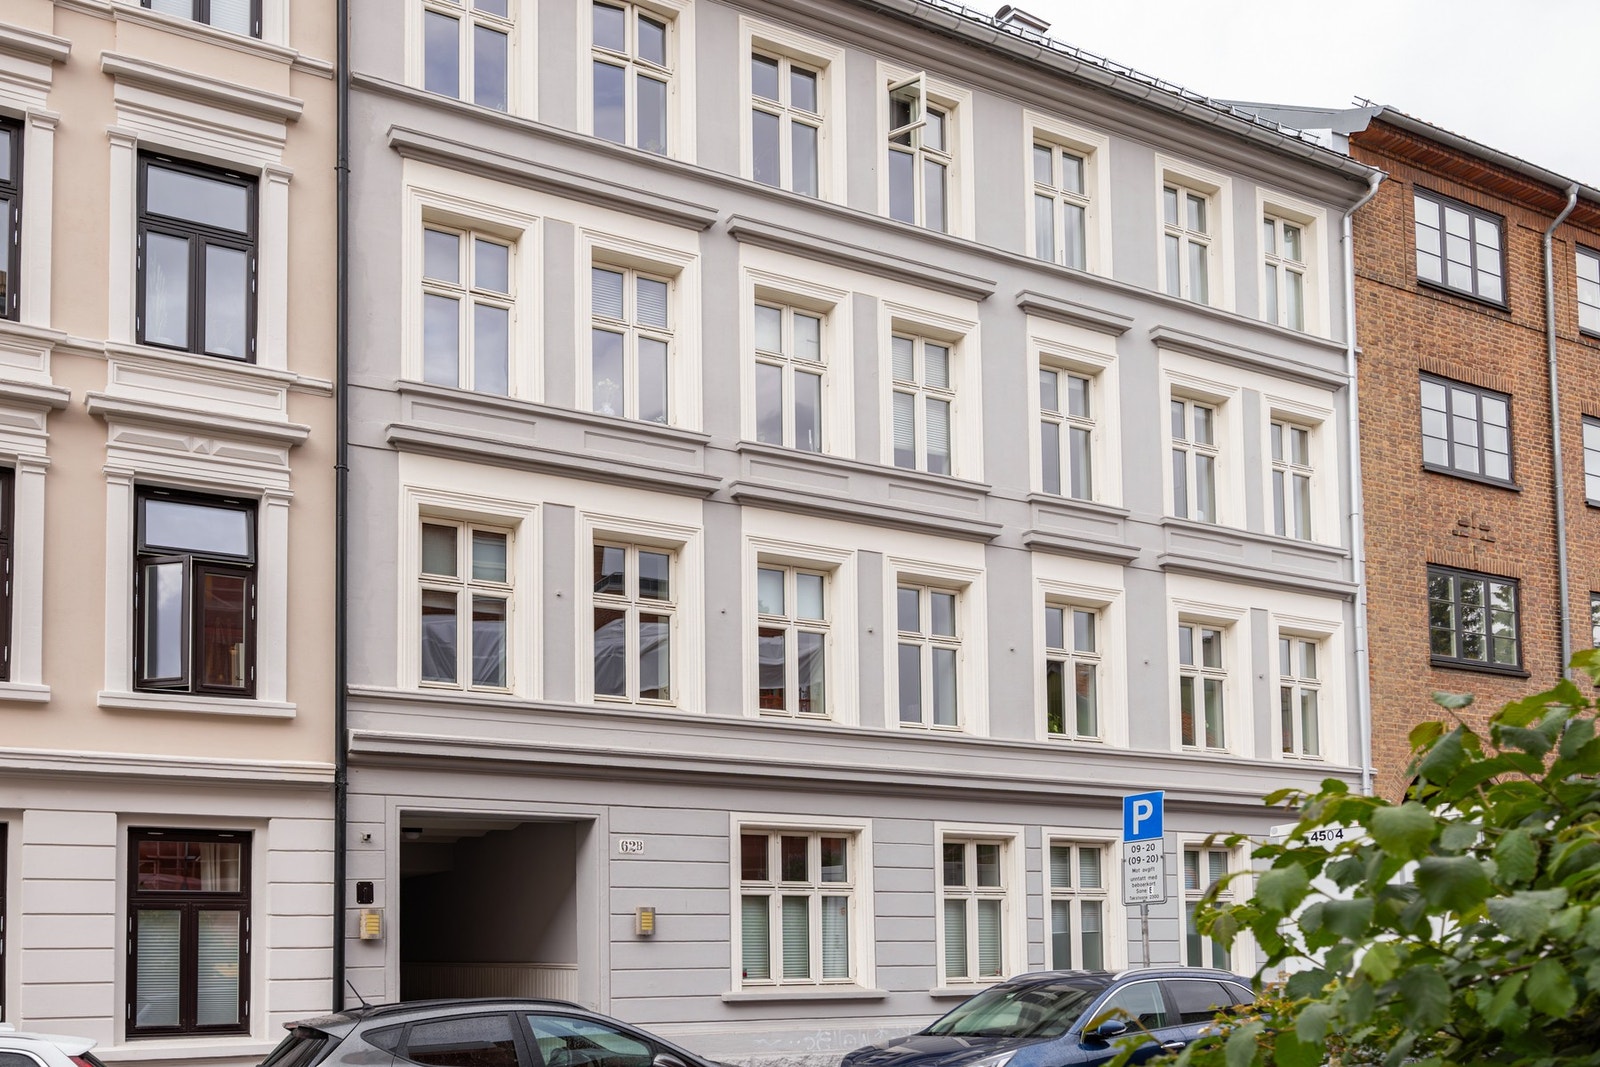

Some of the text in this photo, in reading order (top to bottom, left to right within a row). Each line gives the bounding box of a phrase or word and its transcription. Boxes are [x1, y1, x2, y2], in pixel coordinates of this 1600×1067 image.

[1133, 799, 1153, 835] P
[1311, 828, 1344, 842] 4504
[621, 840, 643, 852] 62B
